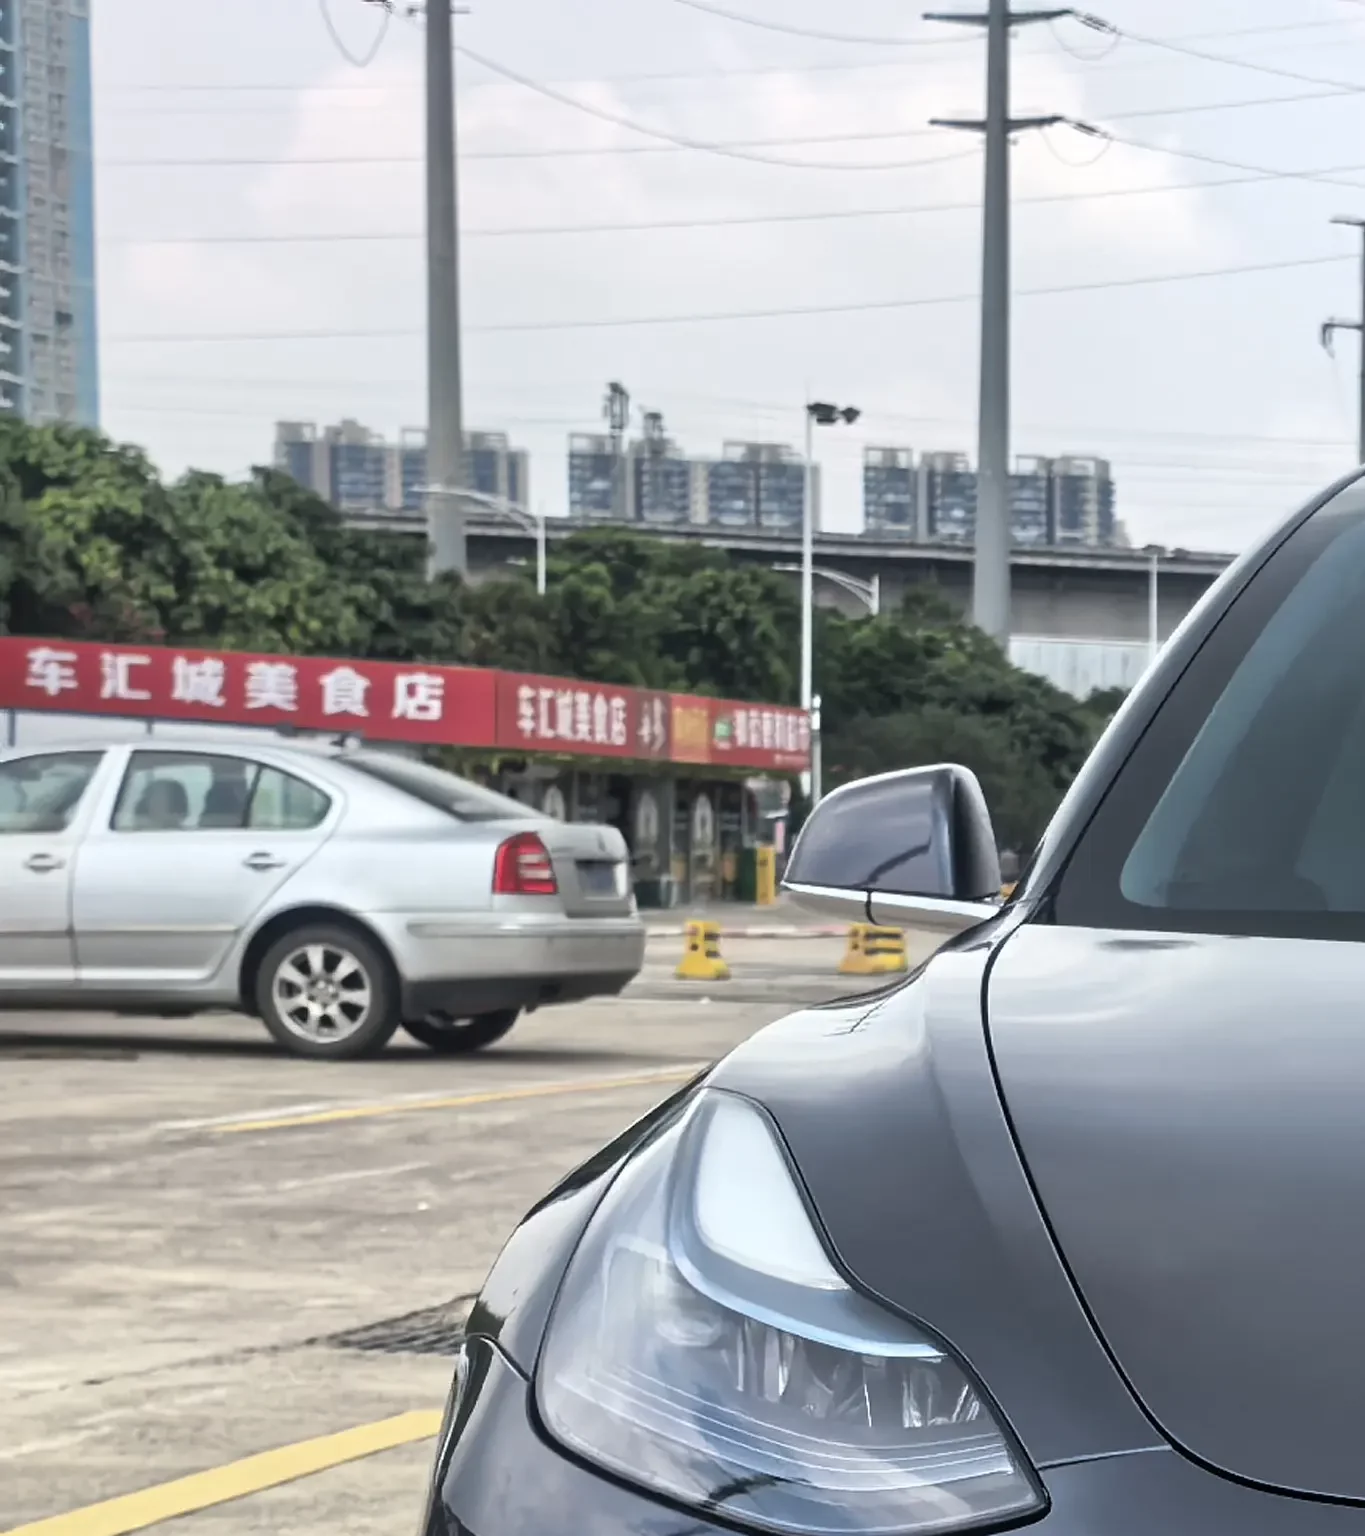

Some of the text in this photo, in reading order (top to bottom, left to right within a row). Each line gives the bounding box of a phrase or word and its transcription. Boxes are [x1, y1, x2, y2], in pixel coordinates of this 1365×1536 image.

[25, 646, 446, 721] 车汇城美食店
[517, 683, 627, 746] 车汇城美食店
